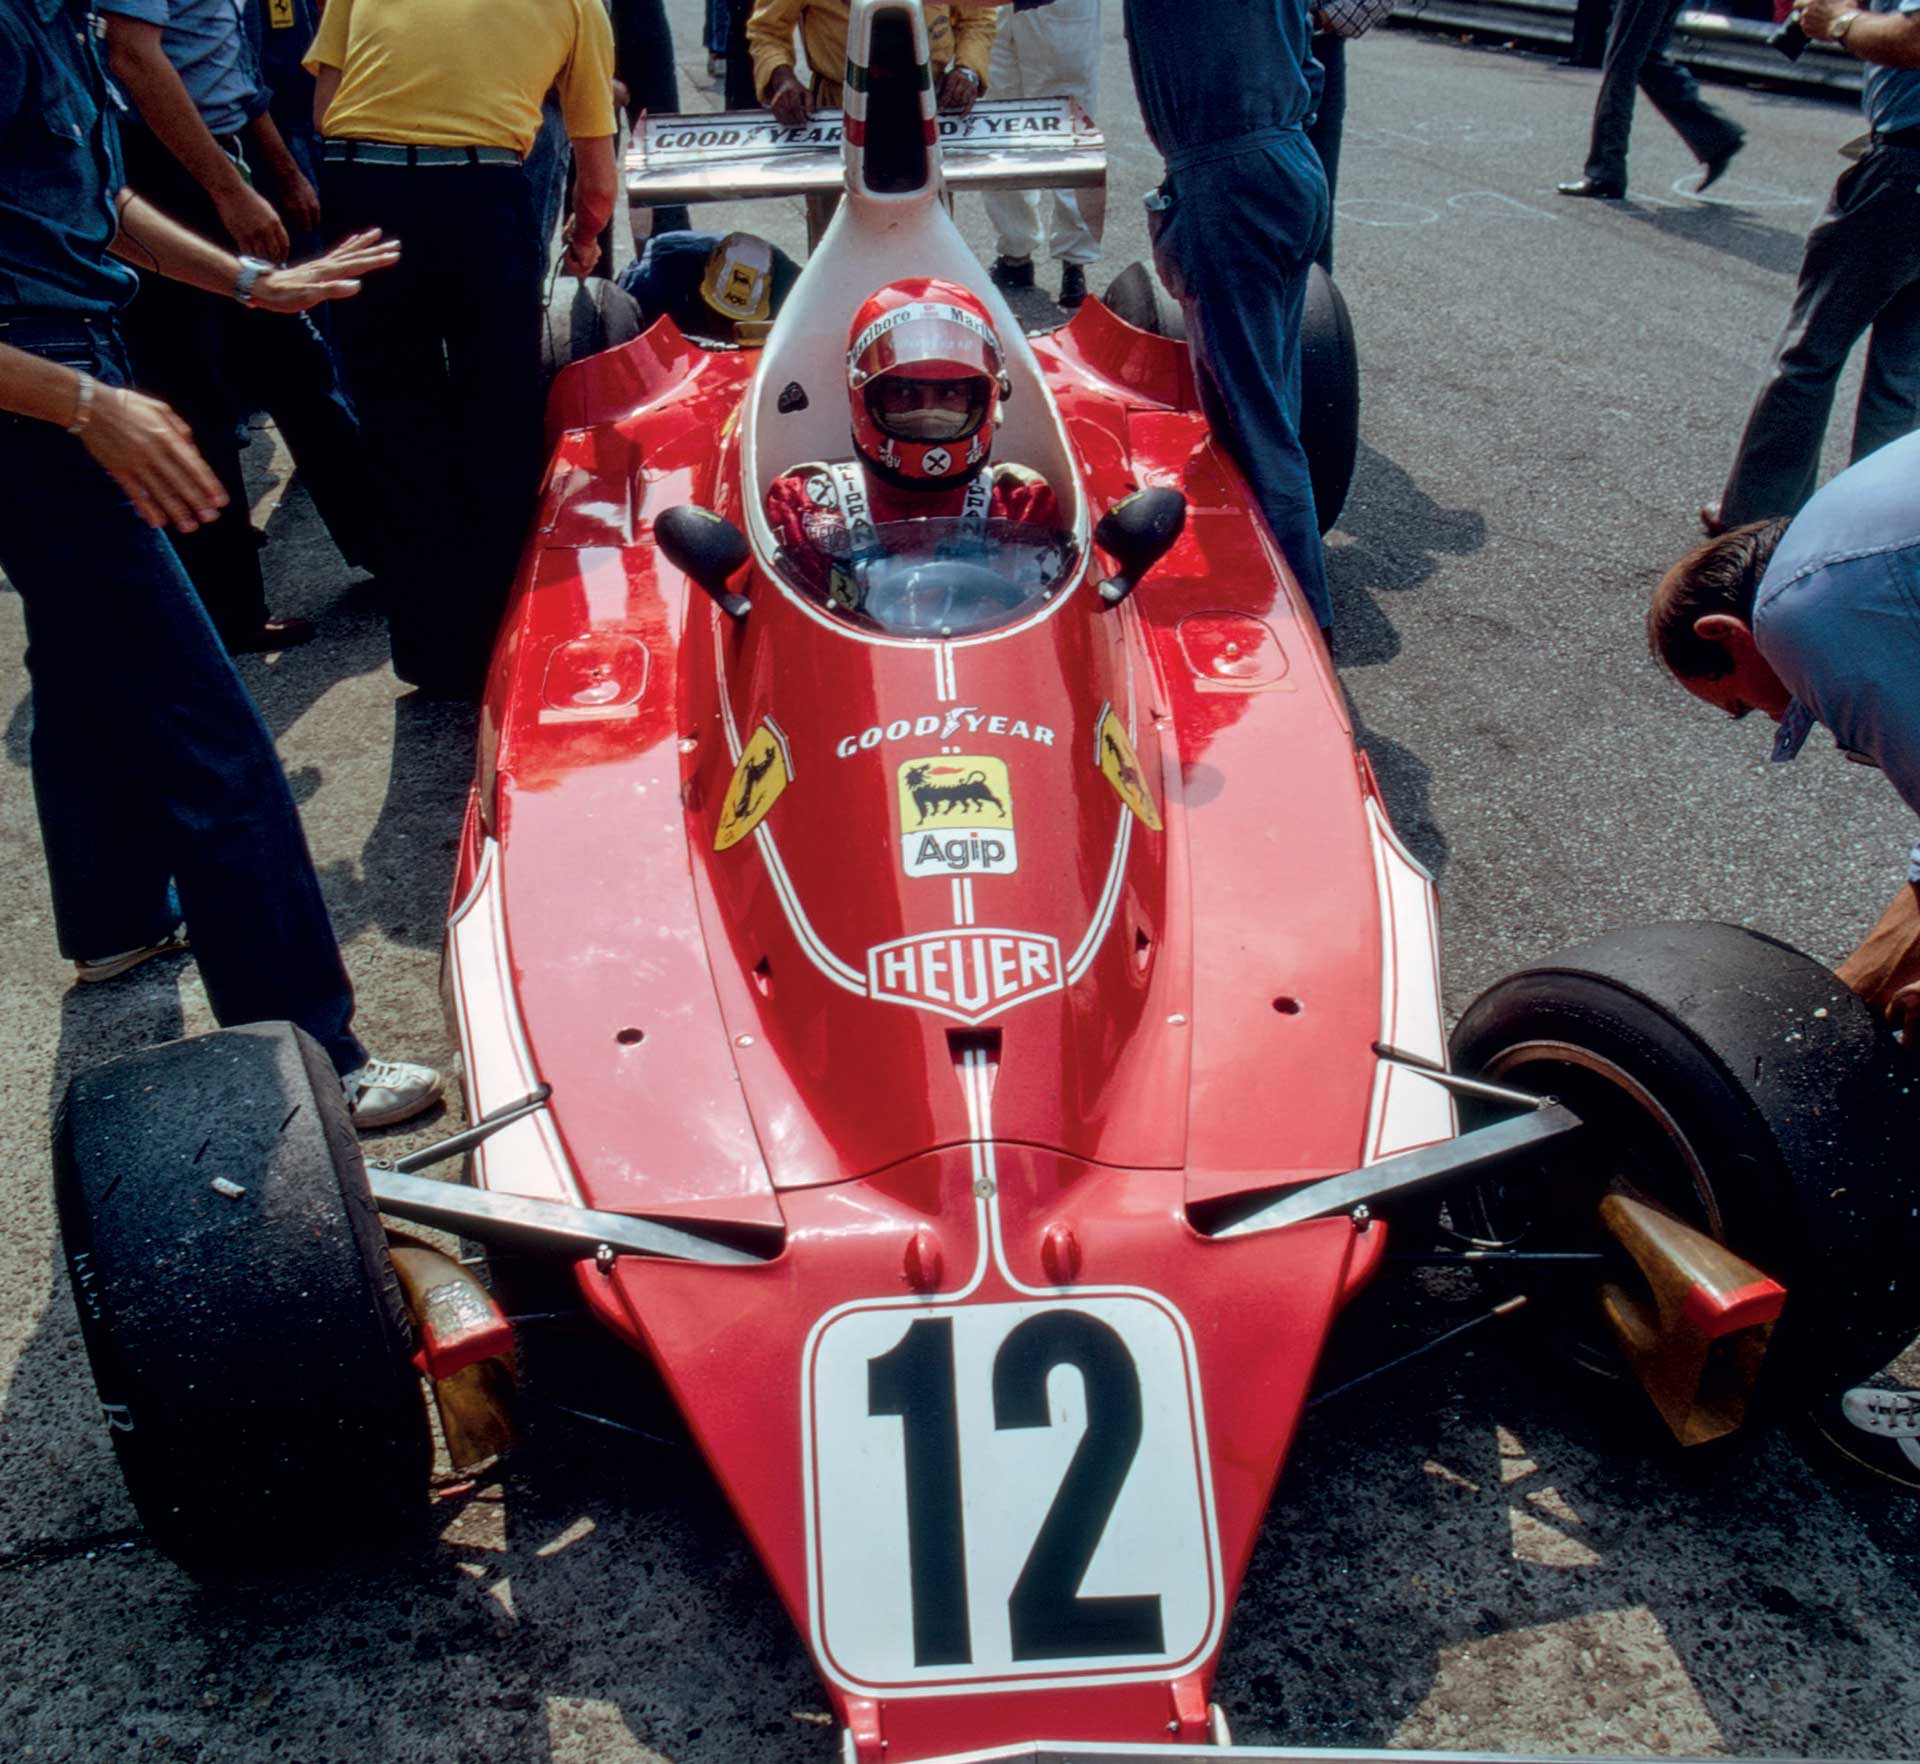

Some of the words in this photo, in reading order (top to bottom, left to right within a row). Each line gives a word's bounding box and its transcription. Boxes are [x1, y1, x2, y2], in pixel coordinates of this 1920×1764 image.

[939, 117, 1061, 136] DYEAR
[836, 711, 1056, 759] GOODYEAR
[914, 832, 1006, 870] Agip
[883, 938, 1052, 1011] HEUER
[867, 1308, 1166, 1668] 12
